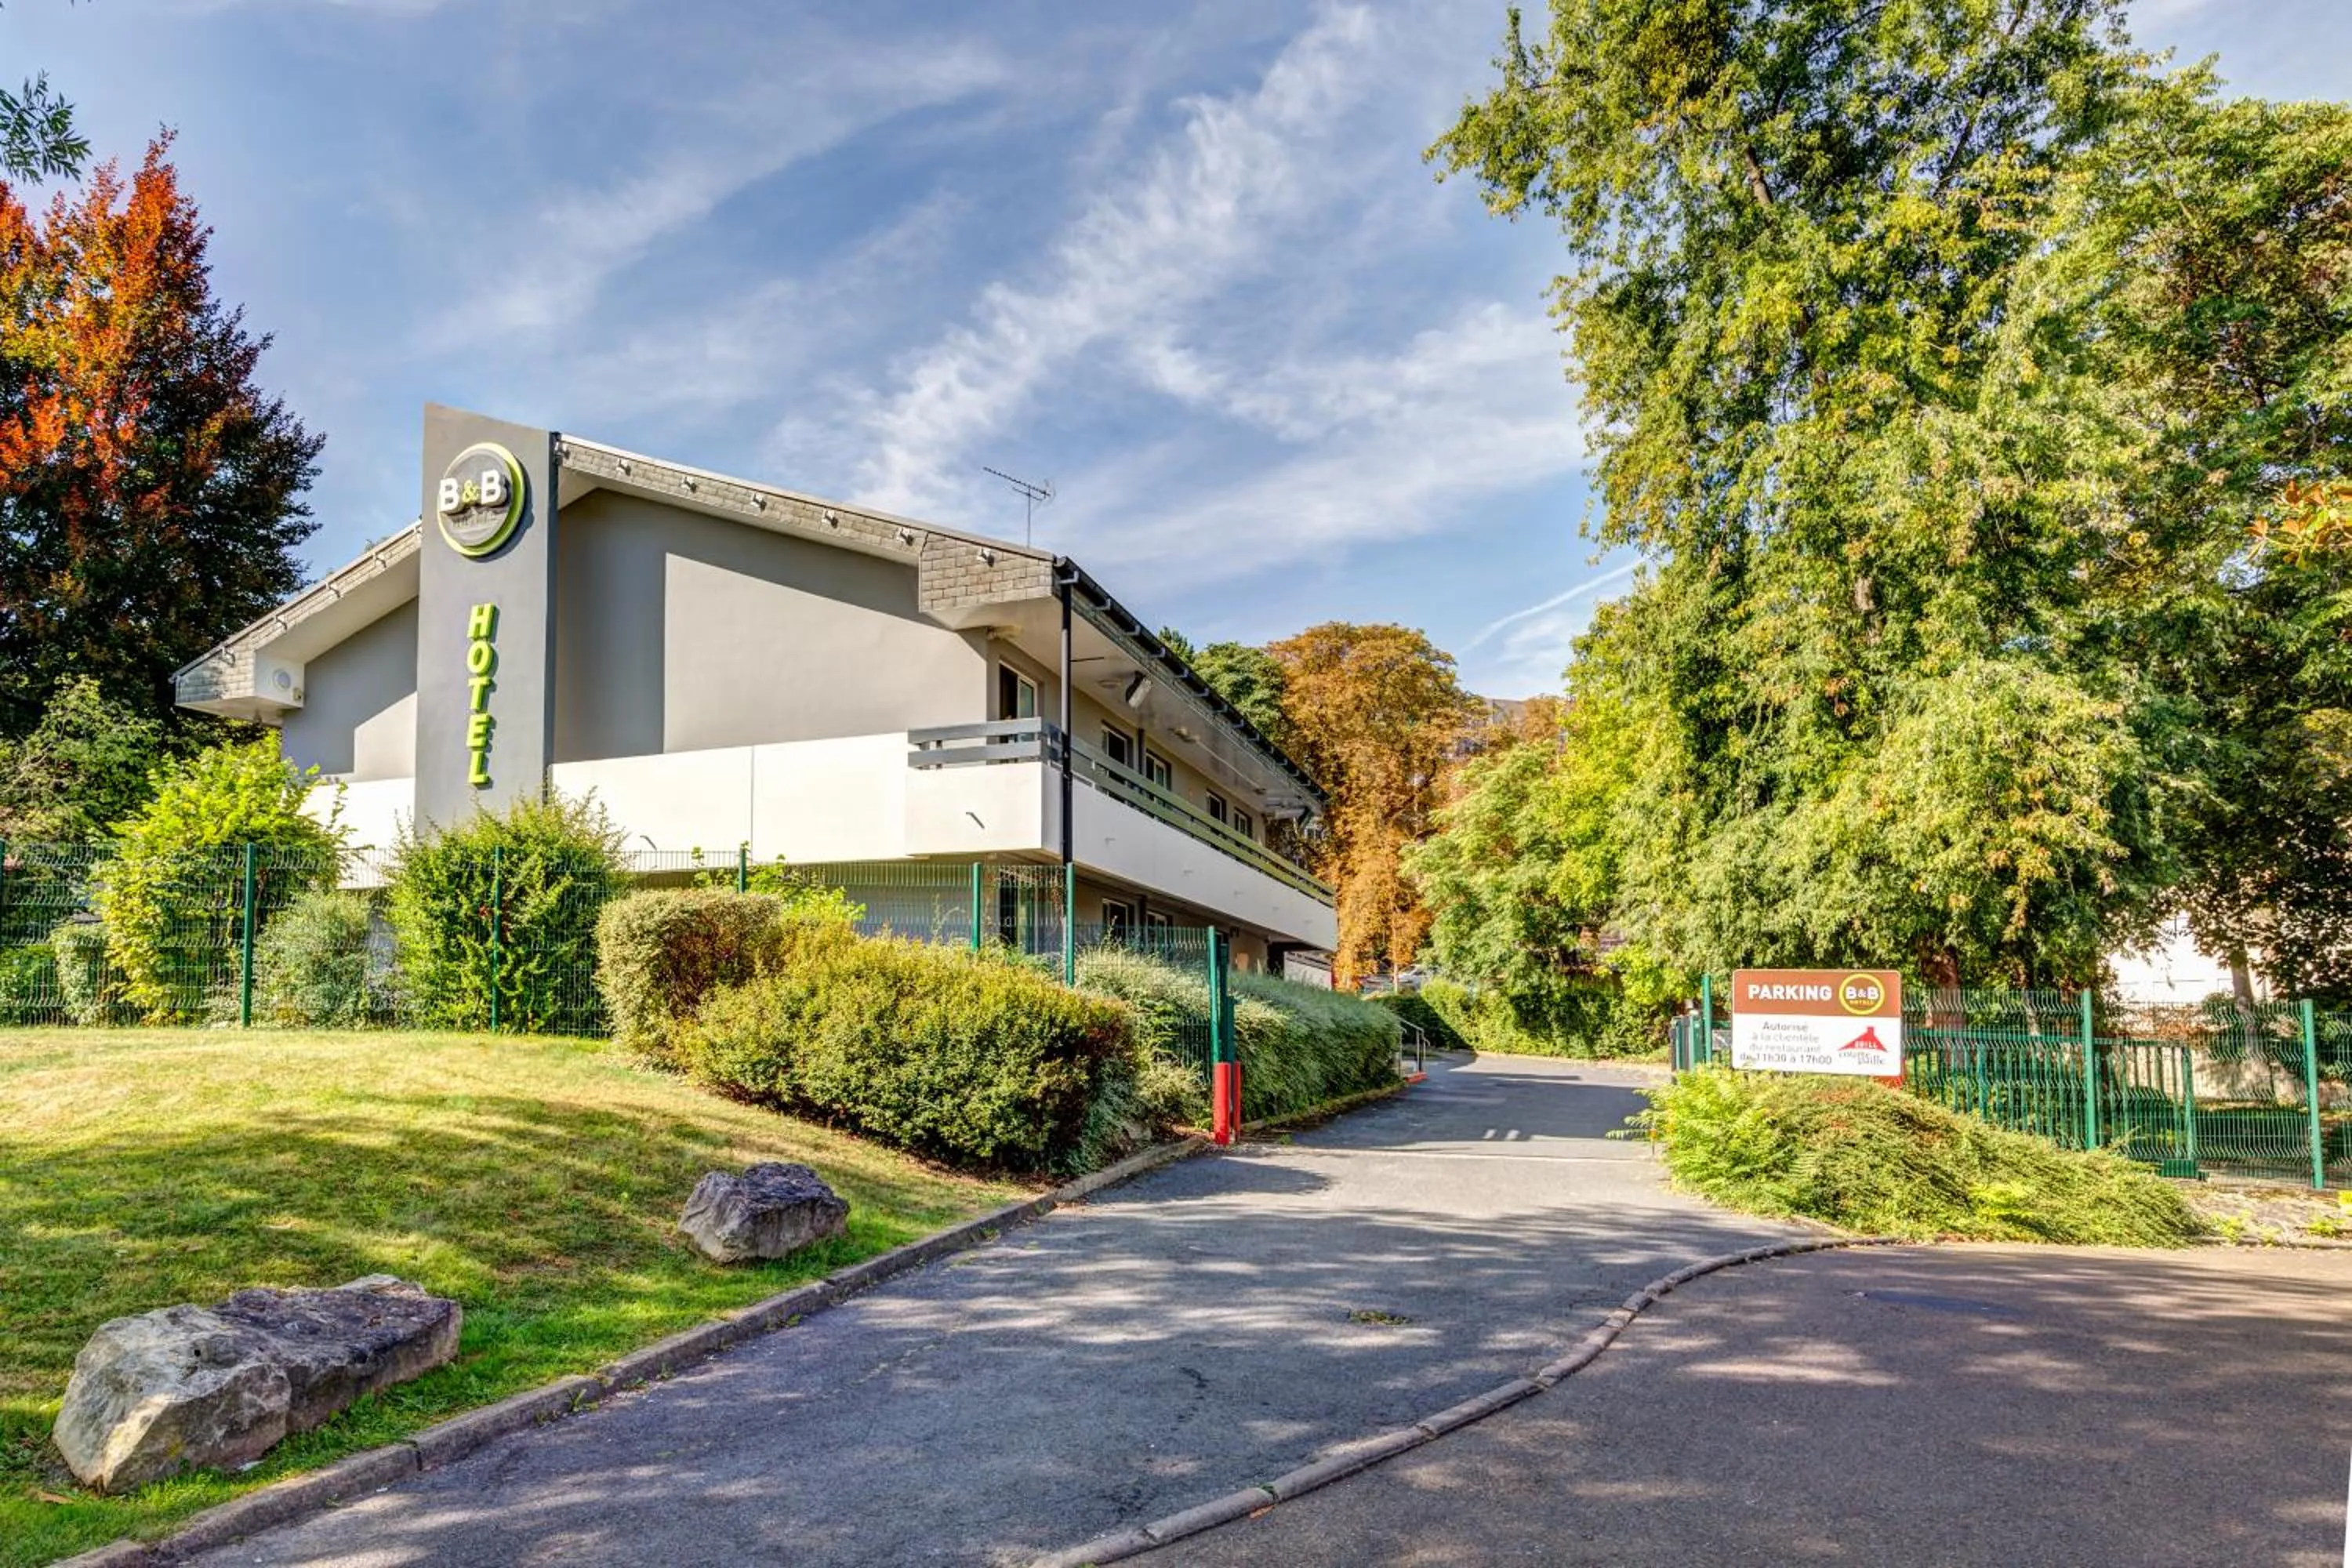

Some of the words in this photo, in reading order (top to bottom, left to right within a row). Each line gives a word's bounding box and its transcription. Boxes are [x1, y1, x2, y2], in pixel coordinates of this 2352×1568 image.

[439, 470, 504, 513] B&B
[466, 602, 496, 786] HOTEL
[1748, 984, 1832, 1001] PARKING
[1845, 985, 1879, 1000] B&B
[1762, 1021, 1809, 1032] Autorisé
[1751, 1032, 1759, 1040] à
[1761, 1033, 1771, 1041] la
[1773, 1033, 1820, 1044] clientèle
[1749, 1043, 1762, 1051] du
[1765, 1044, 1821, 1053] restaurant
[1753, 1052, 1787, 1062] 11h30
[1801, 1054, 1832, 1065] 17h00
